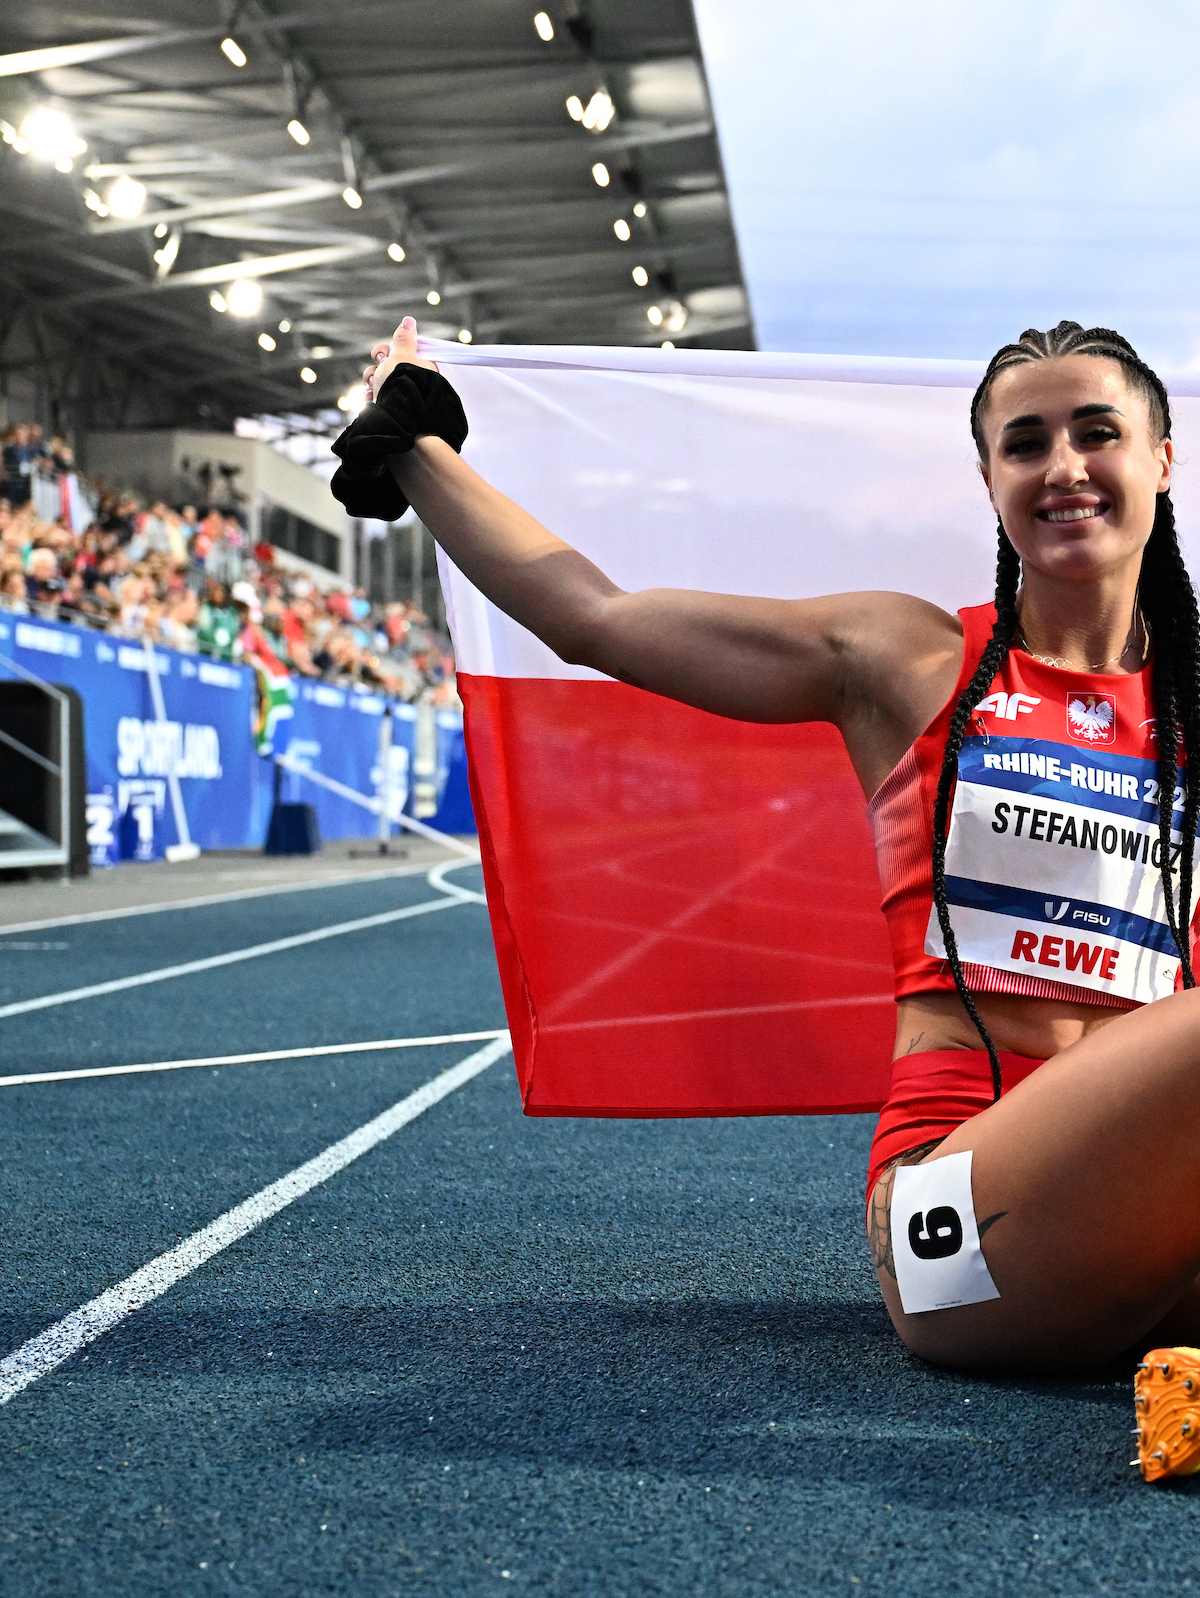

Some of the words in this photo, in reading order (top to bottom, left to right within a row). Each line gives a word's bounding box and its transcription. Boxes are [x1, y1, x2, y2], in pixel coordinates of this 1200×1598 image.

[983, 752, 1139, 801] RHINE-RUHR
[1072, 909, 1111, 926] FISU
[1010, 929, 1120, 981] REWE
